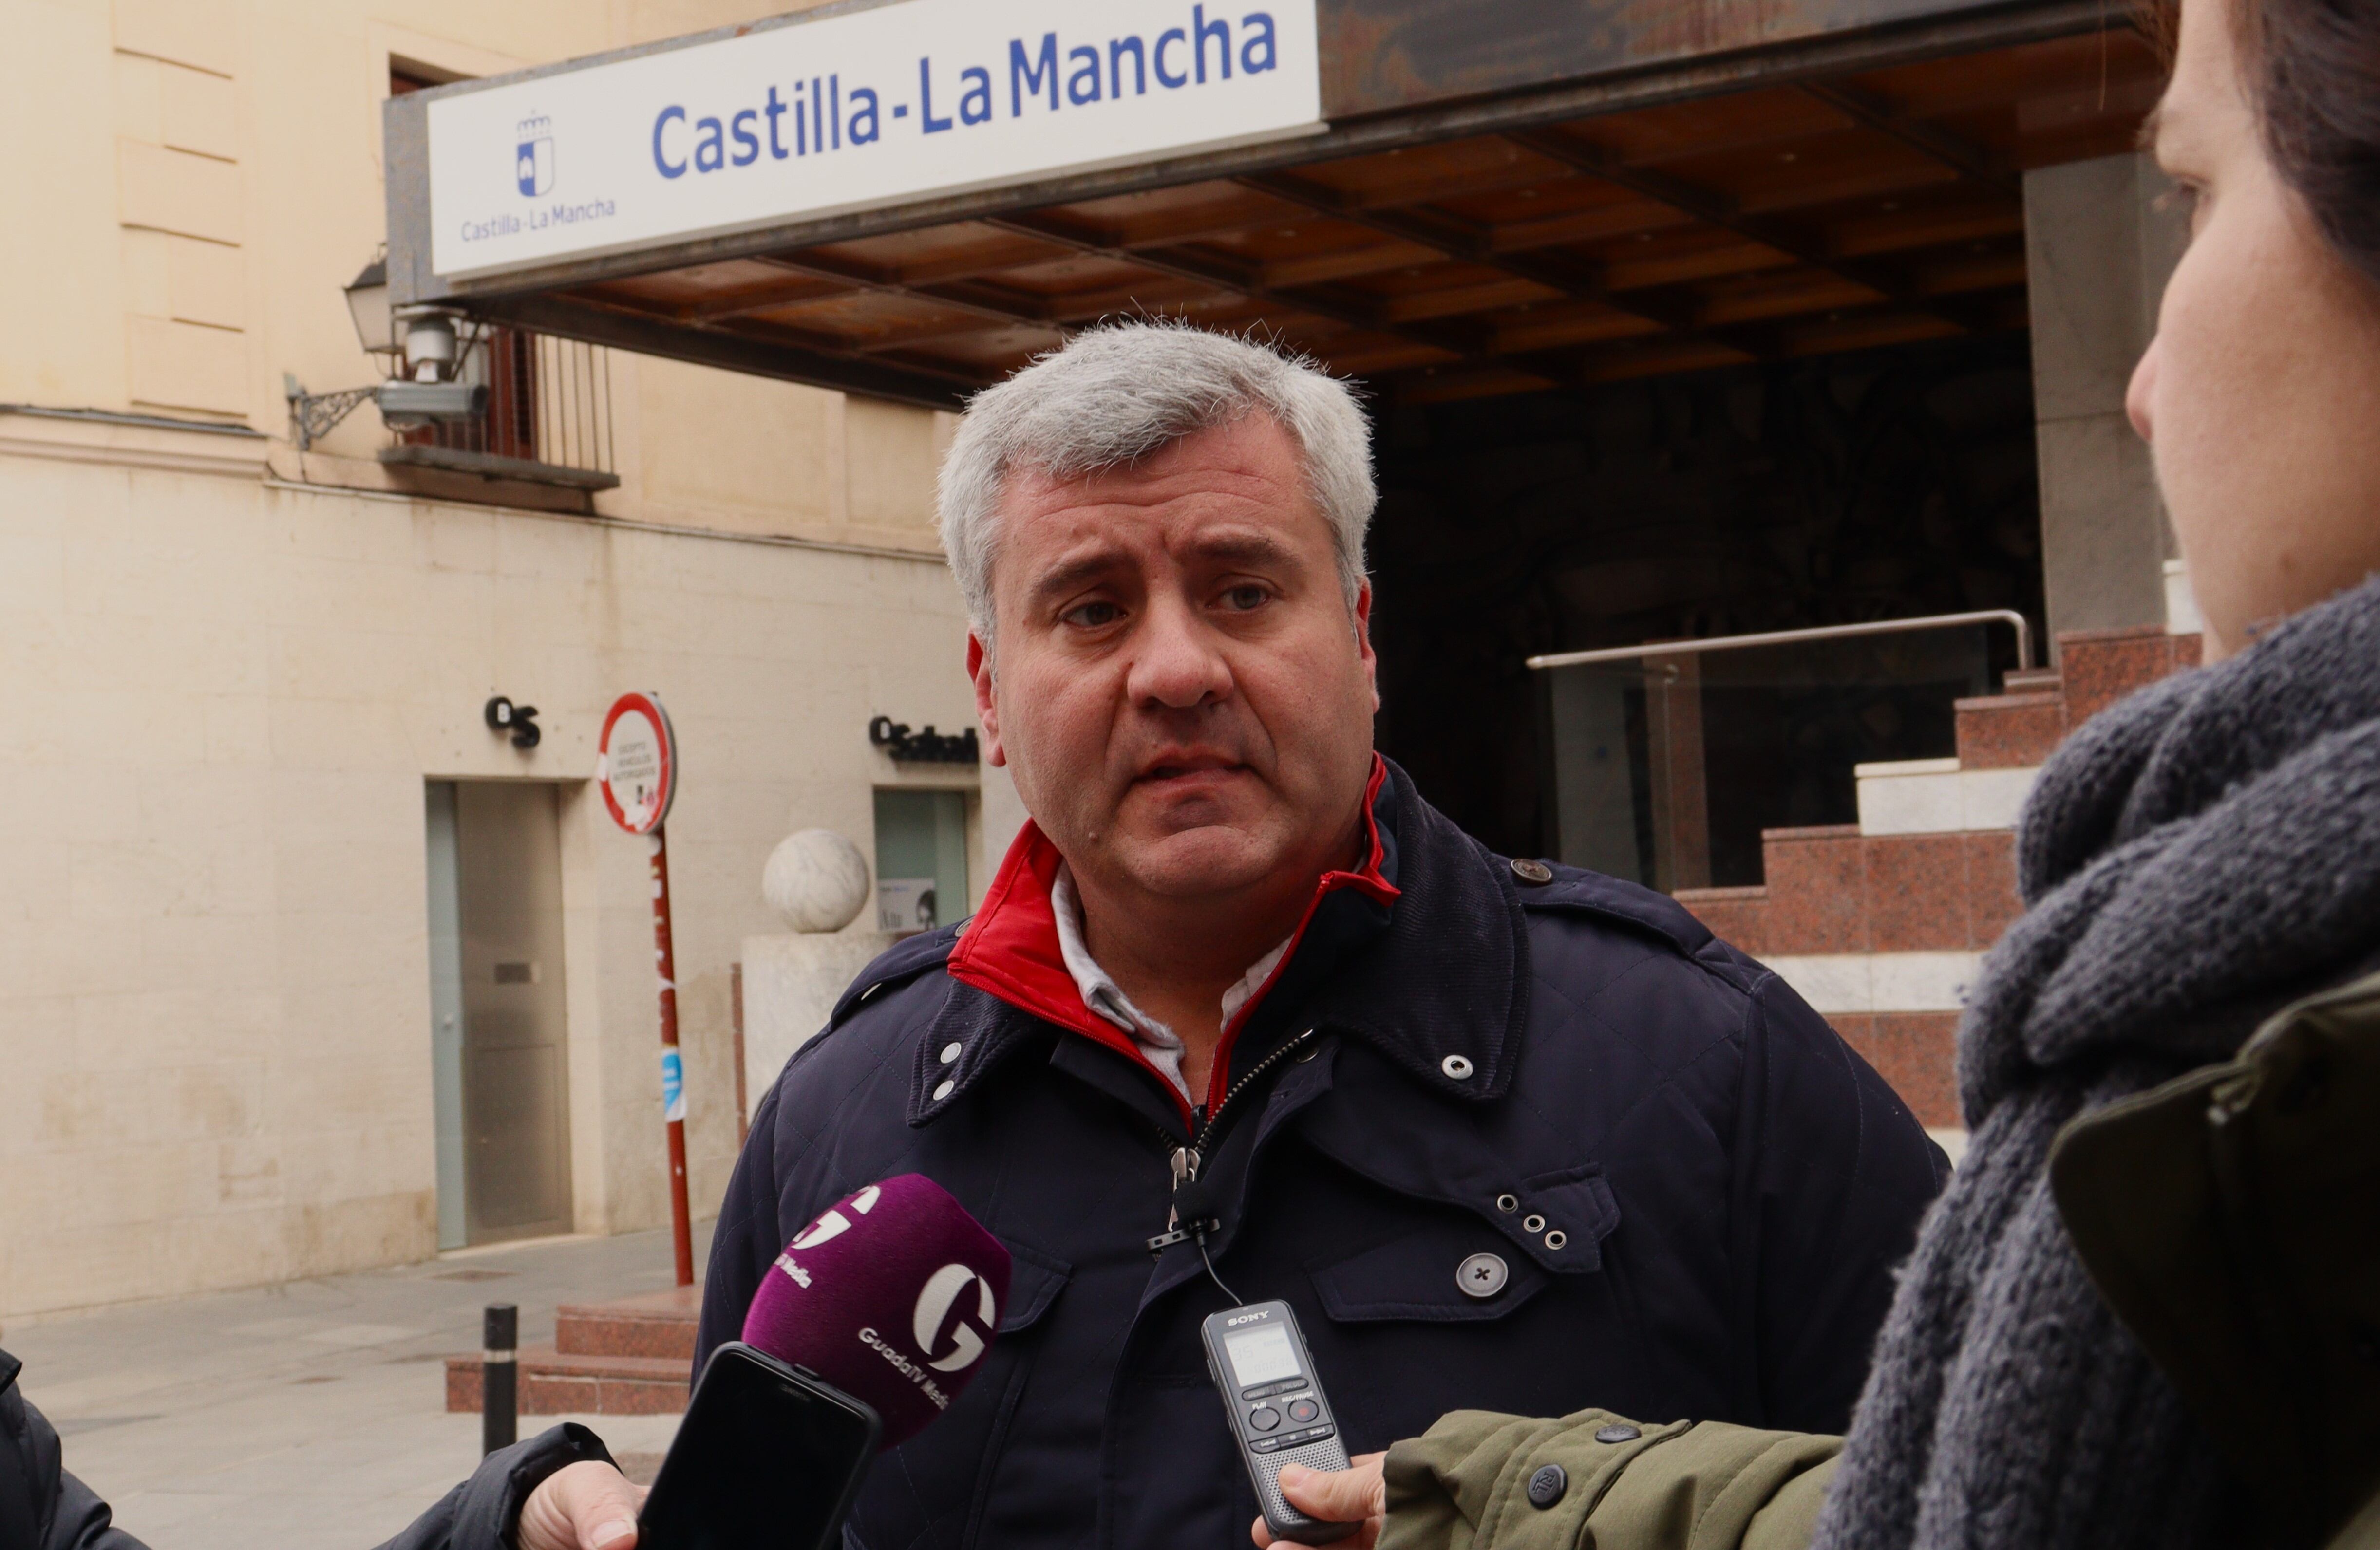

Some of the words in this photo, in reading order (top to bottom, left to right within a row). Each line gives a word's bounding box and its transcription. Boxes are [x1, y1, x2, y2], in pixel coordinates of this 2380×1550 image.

[1009, 3, 1277, 117] Mancha
[553, 198, 615, 226] Mancha
[1228, 1310, 1269, 1326] SONY
[858, 1327, 928, 1383] GuadaTV
[1252, 1401, 1267, 1410] PLAY
[1281, 1391, 1314, 1403] REC/PAUSE
